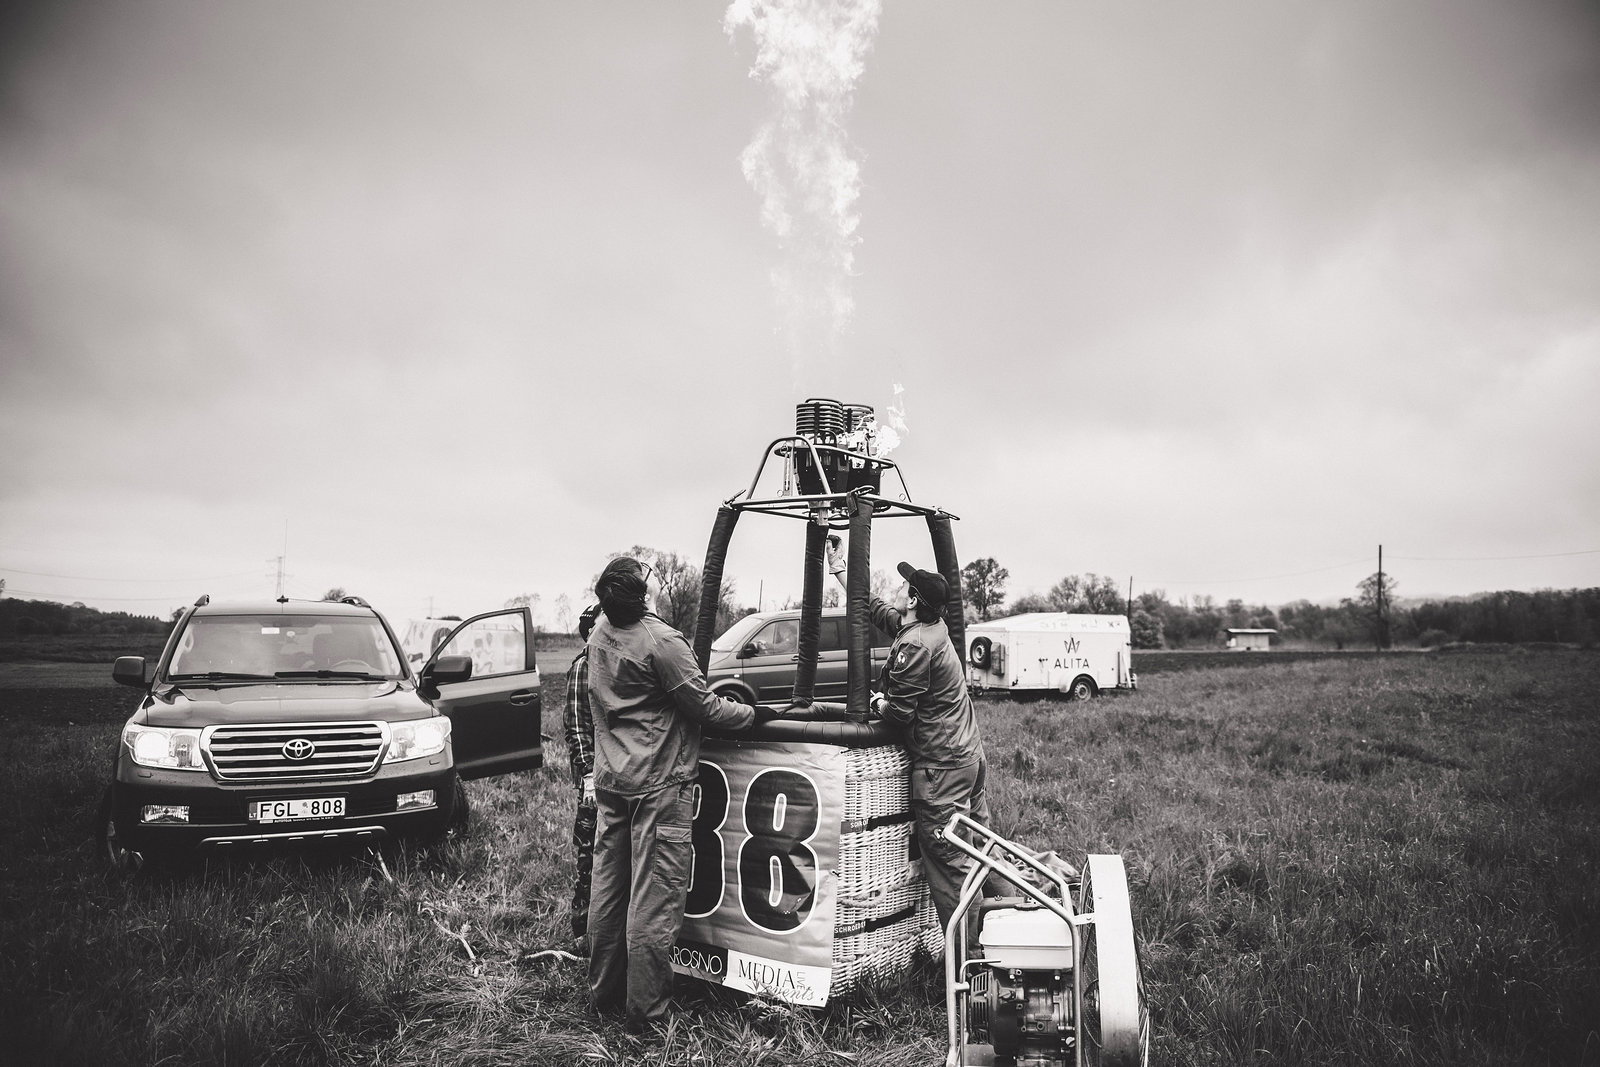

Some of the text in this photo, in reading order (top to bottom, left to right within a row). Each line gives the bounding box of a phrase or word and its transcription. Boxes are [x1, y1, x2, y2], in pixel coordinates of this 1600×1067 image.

[1054, 658, 1089, 669] ALITA
[260, 800, 342, 818] FGL 808
[738, 958, 796, 990] MEDIA
